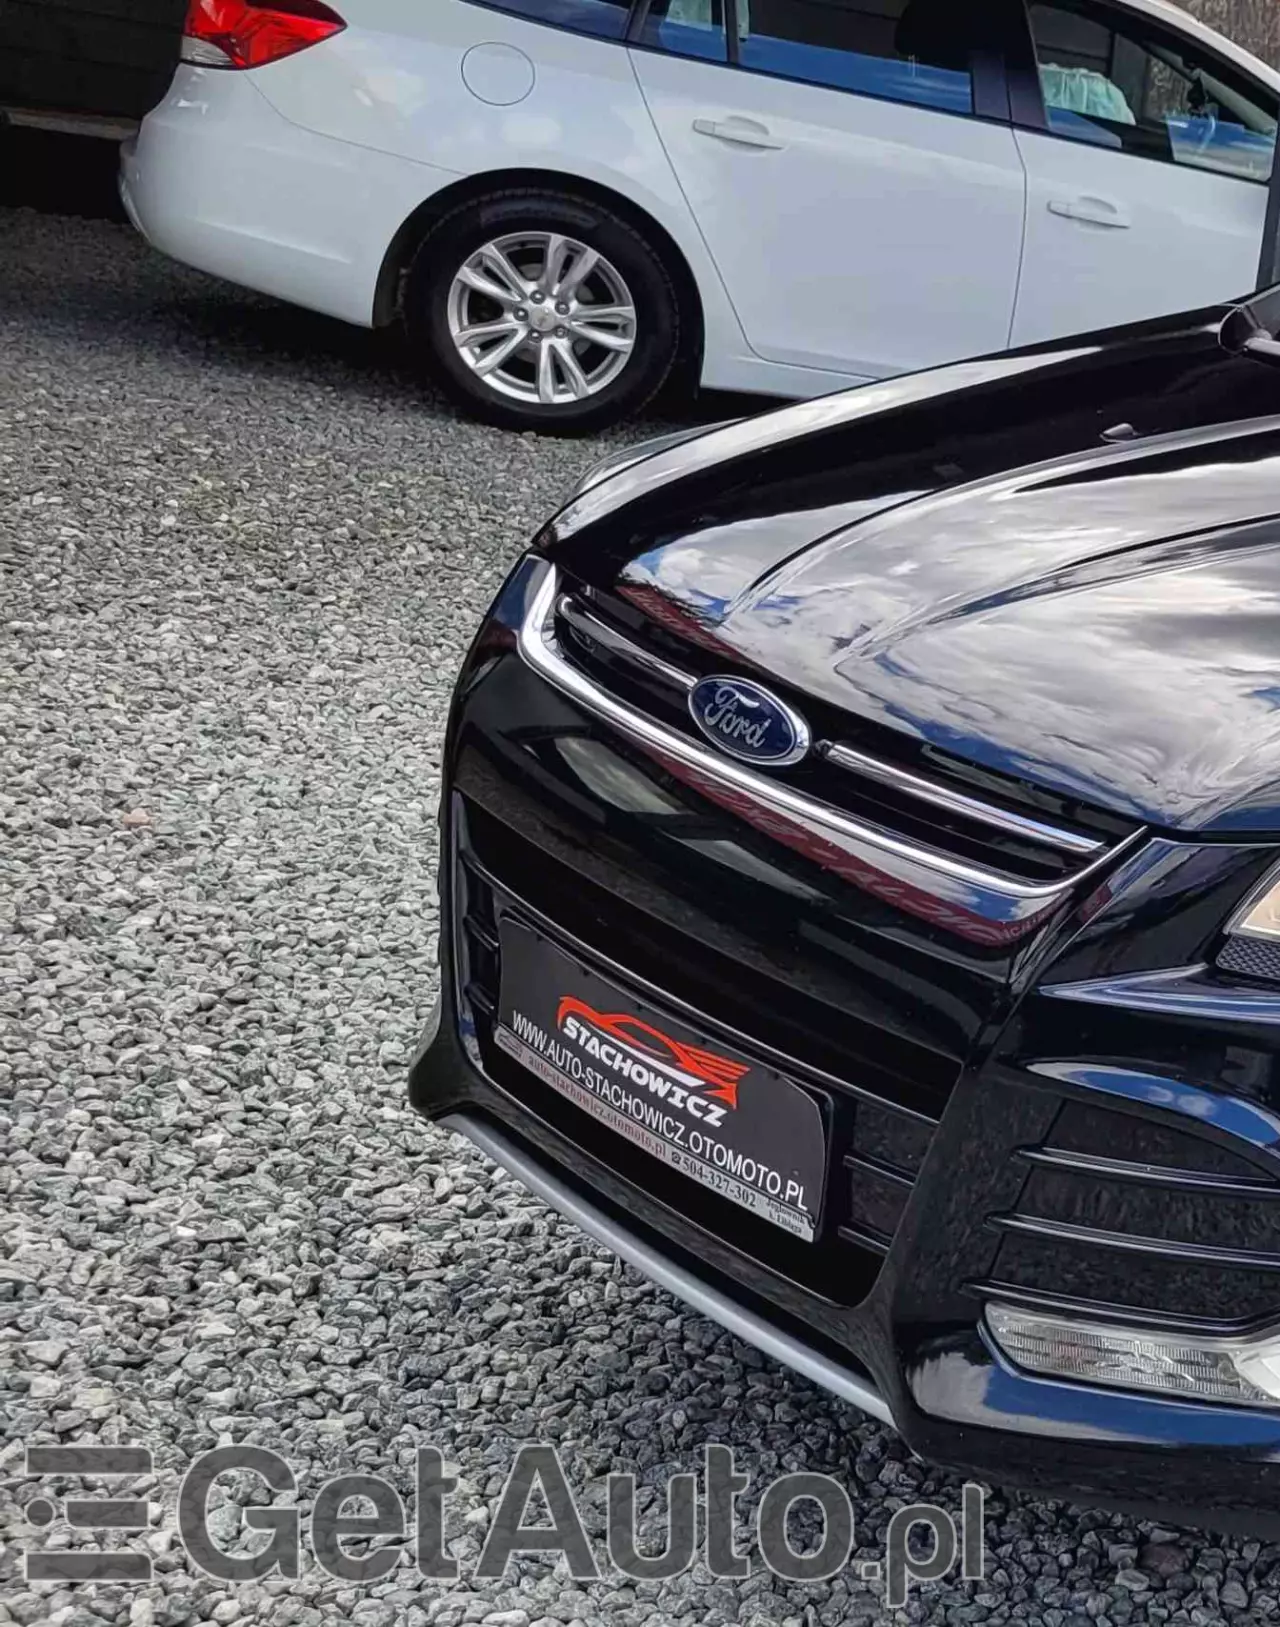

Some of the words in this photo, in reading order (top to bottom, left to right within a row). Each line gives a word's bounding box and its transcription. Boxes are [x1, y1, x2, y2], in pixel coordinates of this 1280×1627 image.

[704, 685, 772, 748] Ford
[513, 1009, 808, 1211] WWW.AUTO-STACHOWICZ.OTOMOTO.PL
[527, 1054, 667, 1158] auto-stachowicz.otomoto.pl
[682, 1157, 757, 1208] 504-327-302
[562, 1016, 729, 1128] STACHOWICZ
